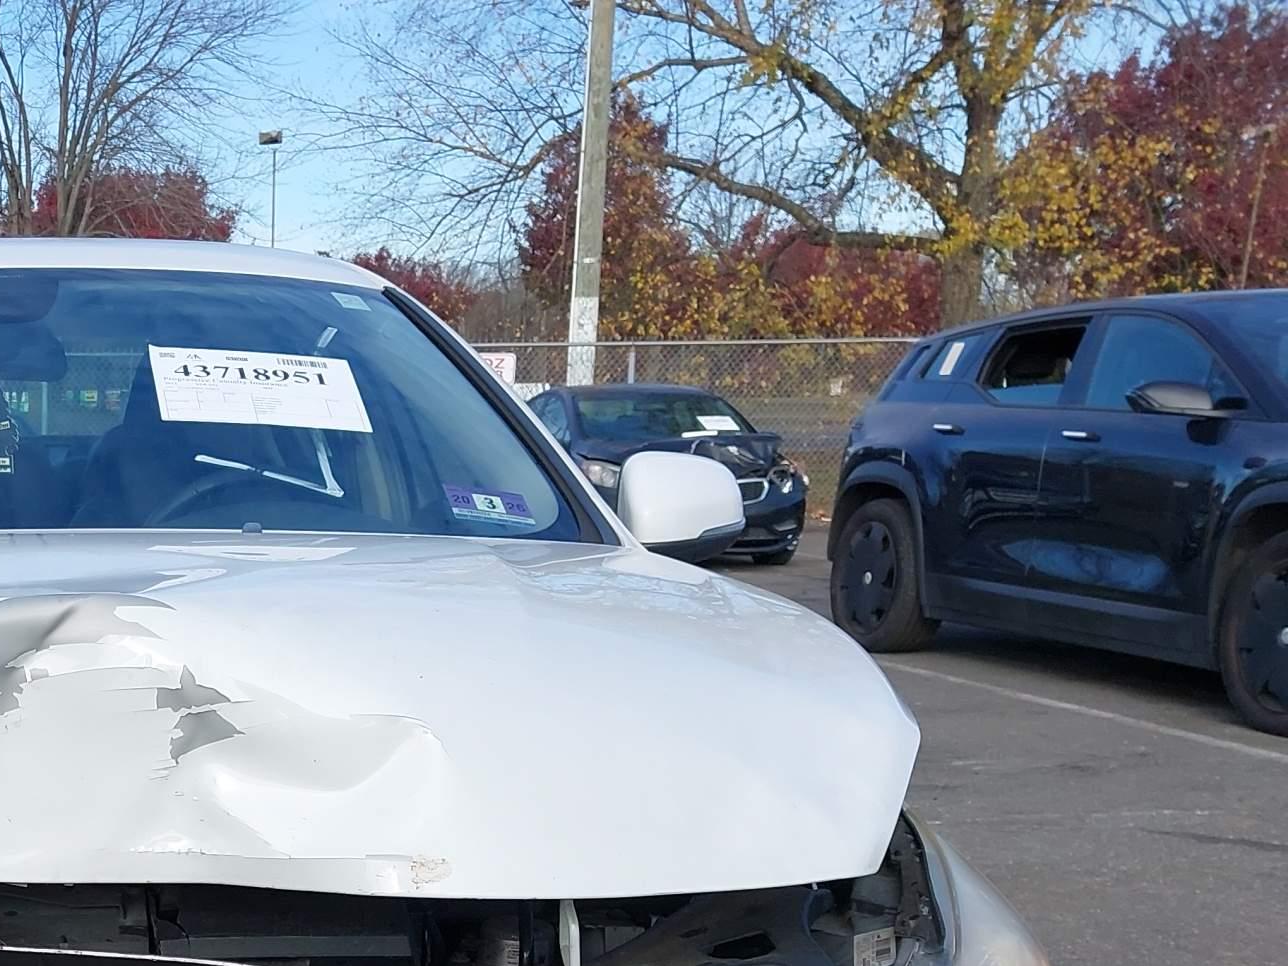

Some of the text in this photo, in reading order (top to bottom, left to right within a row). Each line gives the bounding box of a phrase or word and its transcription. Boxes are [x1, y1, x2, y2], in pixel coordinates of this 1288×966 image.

[174, 364, 328, 386] 43718951
[452, 494, 470, 505] 20
[483, 497, 497, 509] 3
